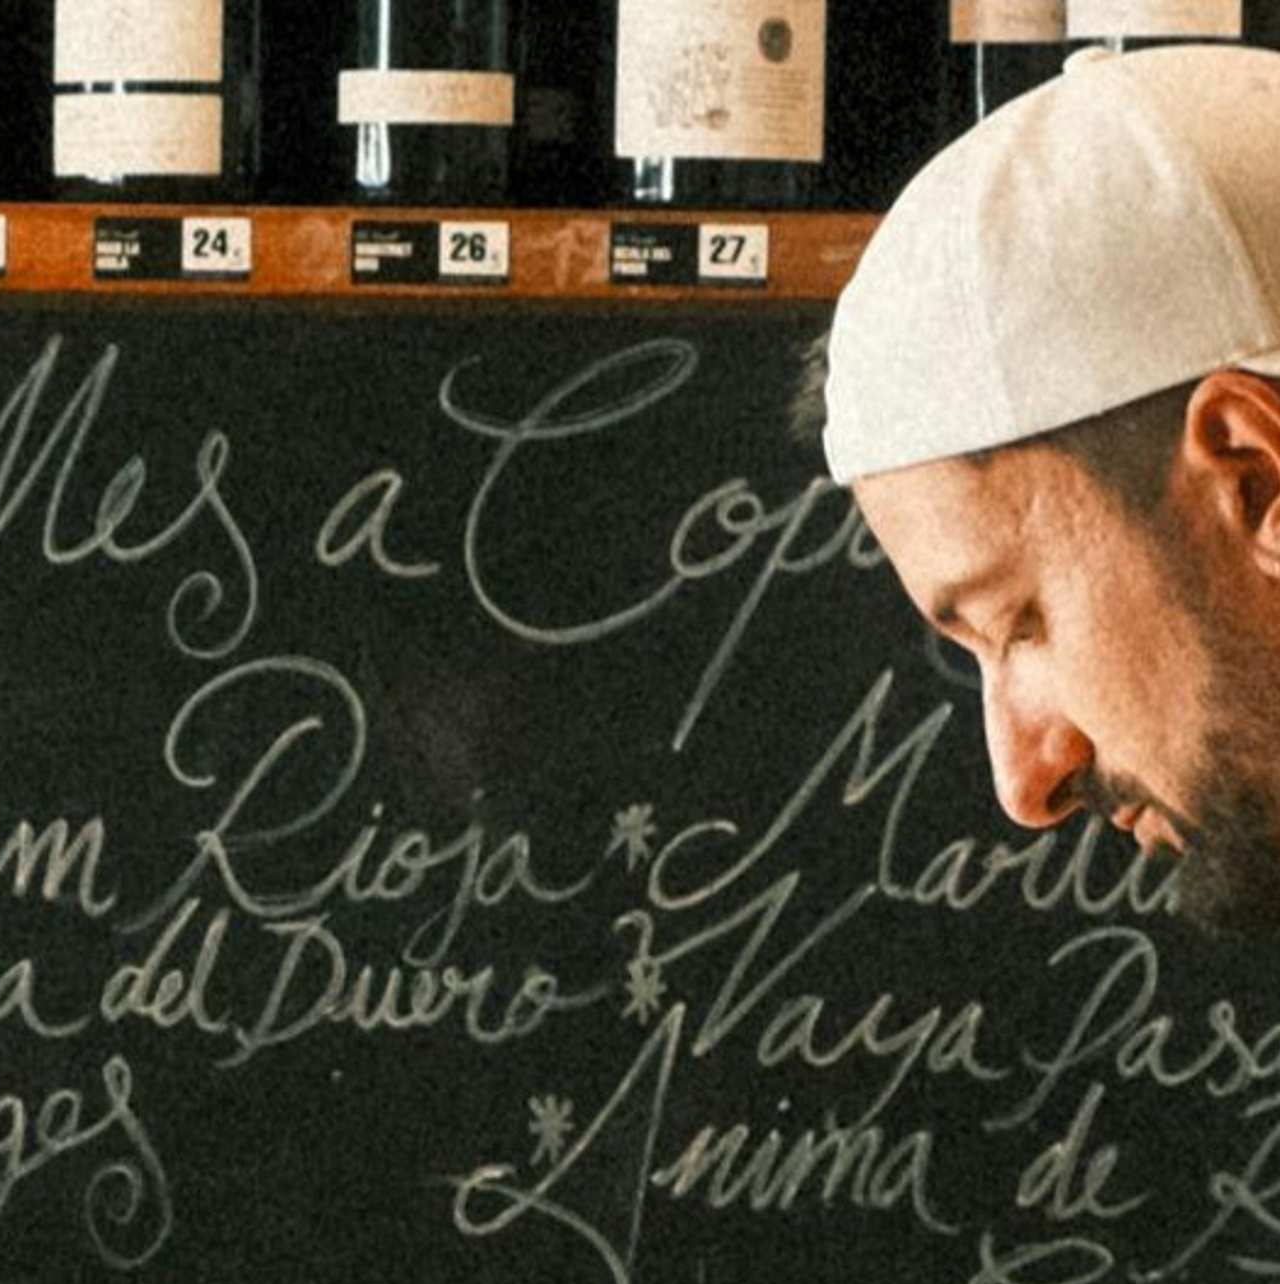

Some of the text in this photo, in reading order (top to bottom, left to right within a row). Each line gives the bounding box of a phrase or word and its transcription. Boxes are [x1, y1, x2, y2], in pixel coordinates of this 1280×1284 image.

[192, 228, 228, 258] 24
[450, 232, 487, 263] 26
[709, 234, 746, 265] 27
[317, 468, 441, 577] a
[120, 655, 600, 968] Rioja
[99, 898, 231, 1034] del
[216, 911, 605, 1072] Duero
[1016, 1081, 1152, 1222] de
